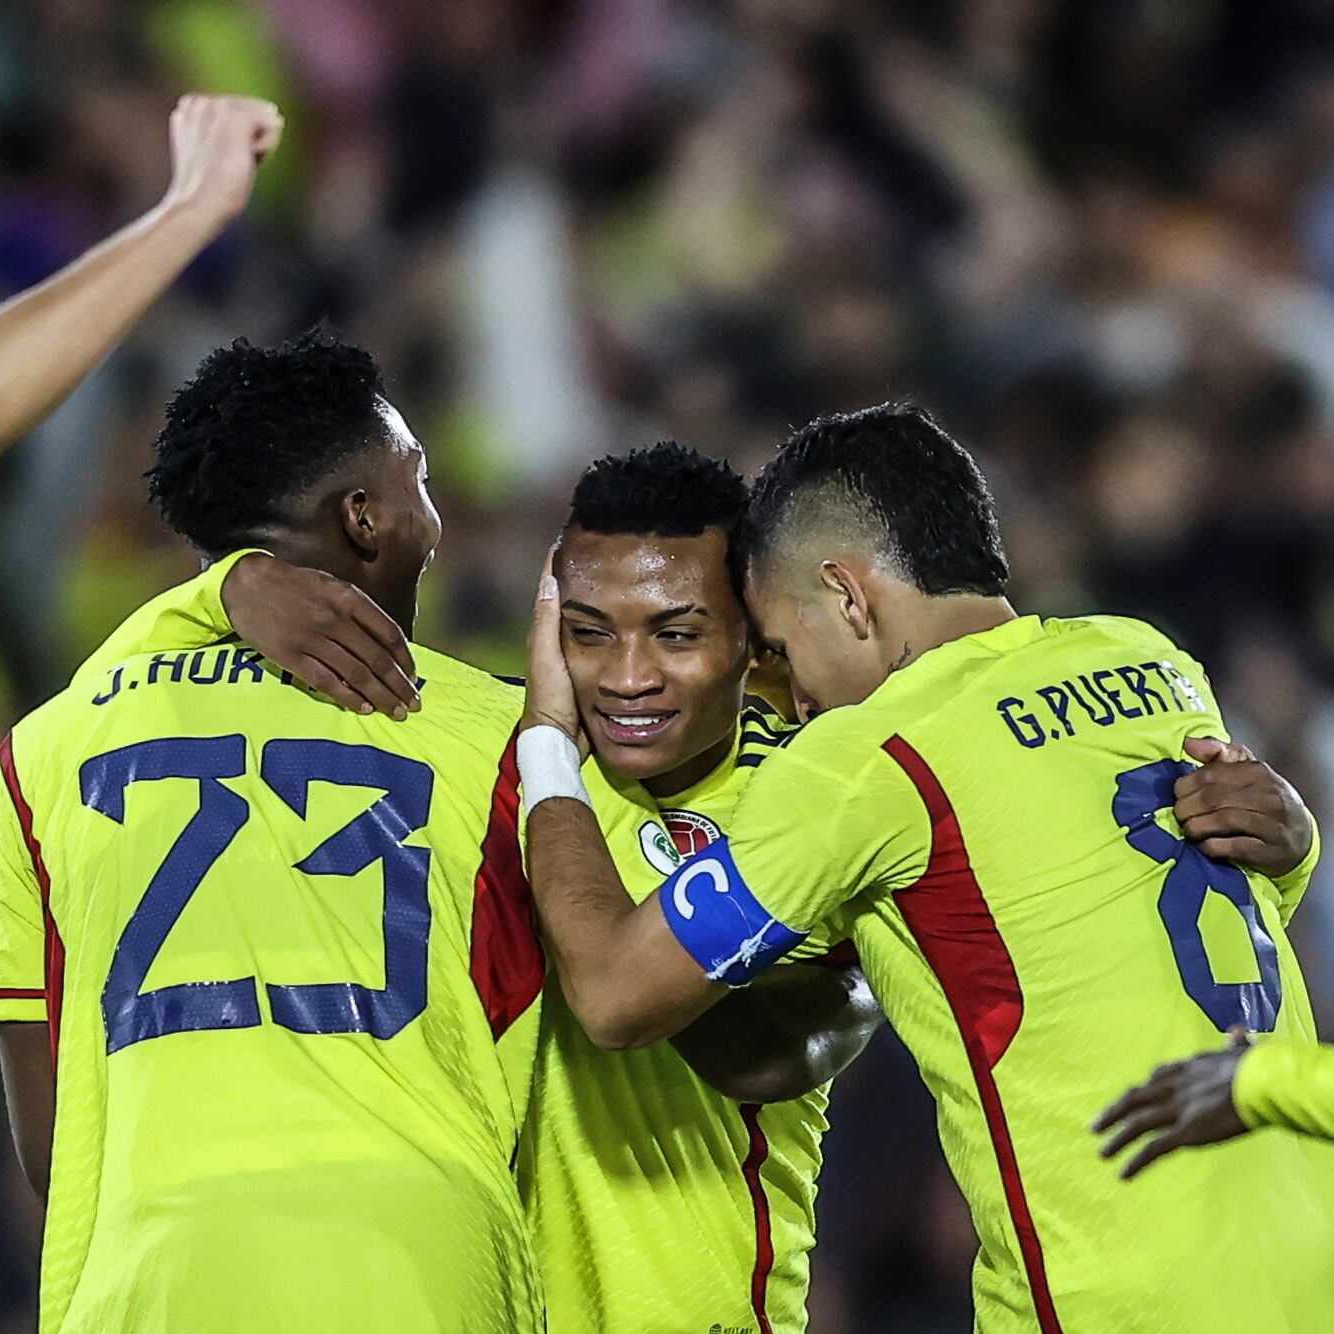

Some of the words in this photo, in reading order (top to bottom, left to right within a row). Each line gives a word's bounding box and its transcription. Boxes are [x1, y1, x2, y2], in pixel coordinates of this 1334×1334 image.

[91, 648, 319, 706] J.HUR
[78, 733, 434, 1056] 23
[673, 858, 729, 920] C
[1111, 757, 1282, 1034] 8
